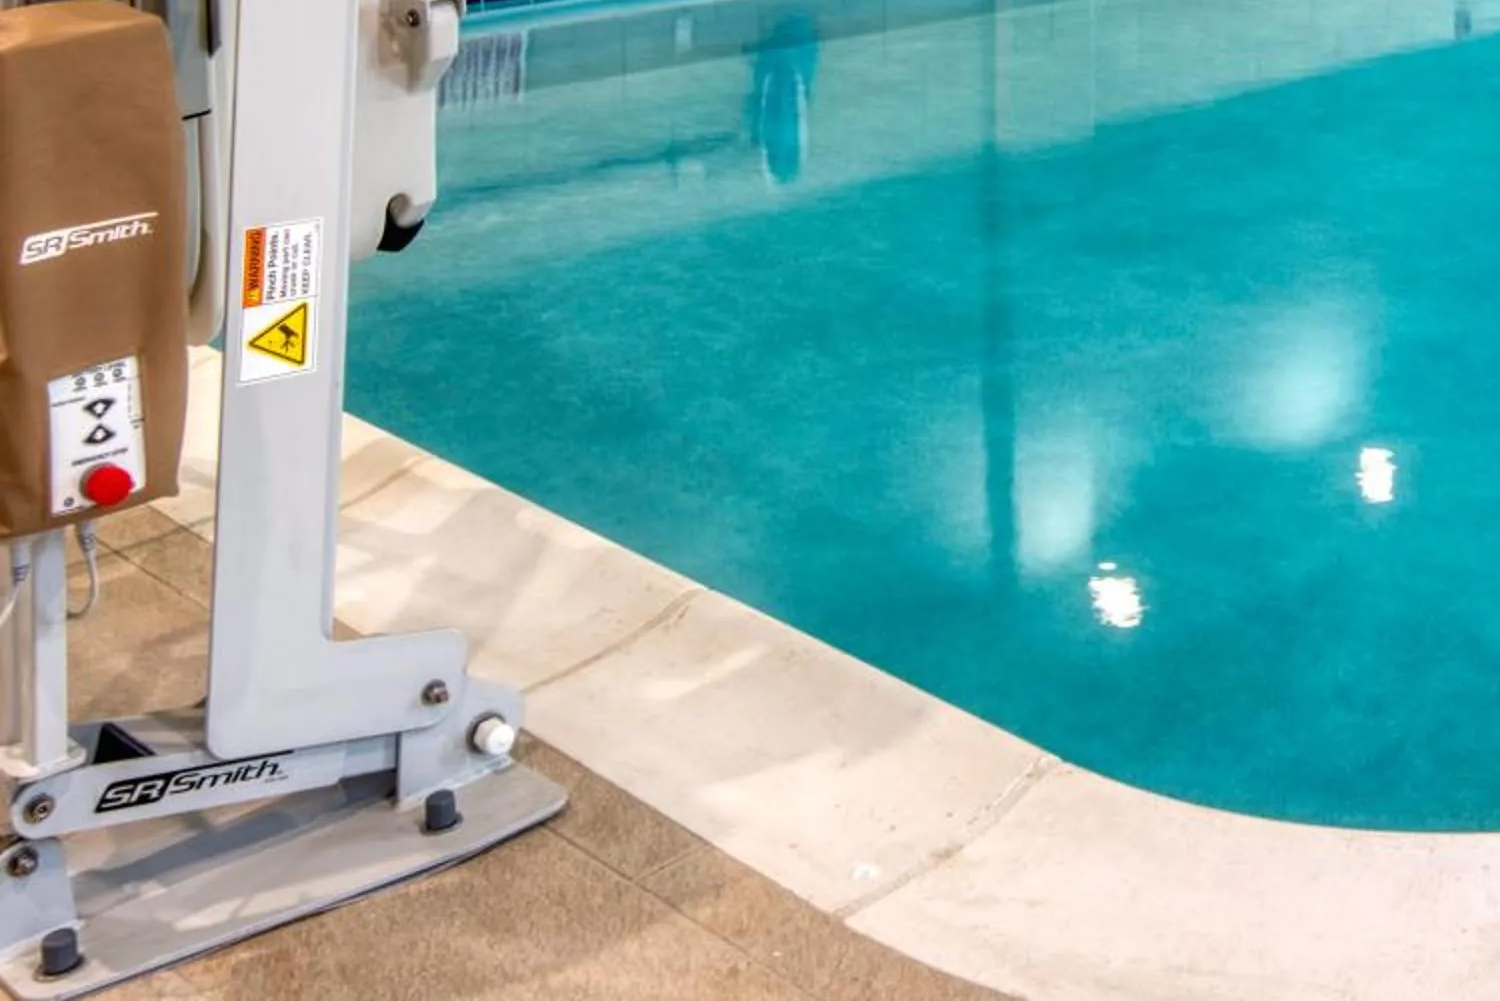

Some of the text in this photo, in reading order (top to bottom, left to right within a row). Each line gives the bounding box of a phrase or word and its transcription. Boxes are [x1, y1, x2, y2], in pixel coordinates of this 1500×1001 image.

[67, 219, 151, 250] Smith
[247, 229, 261, 291] WARNING
[266, 270, 278, 300] Pinch
[100, 759, 281, 809] SR Smith
